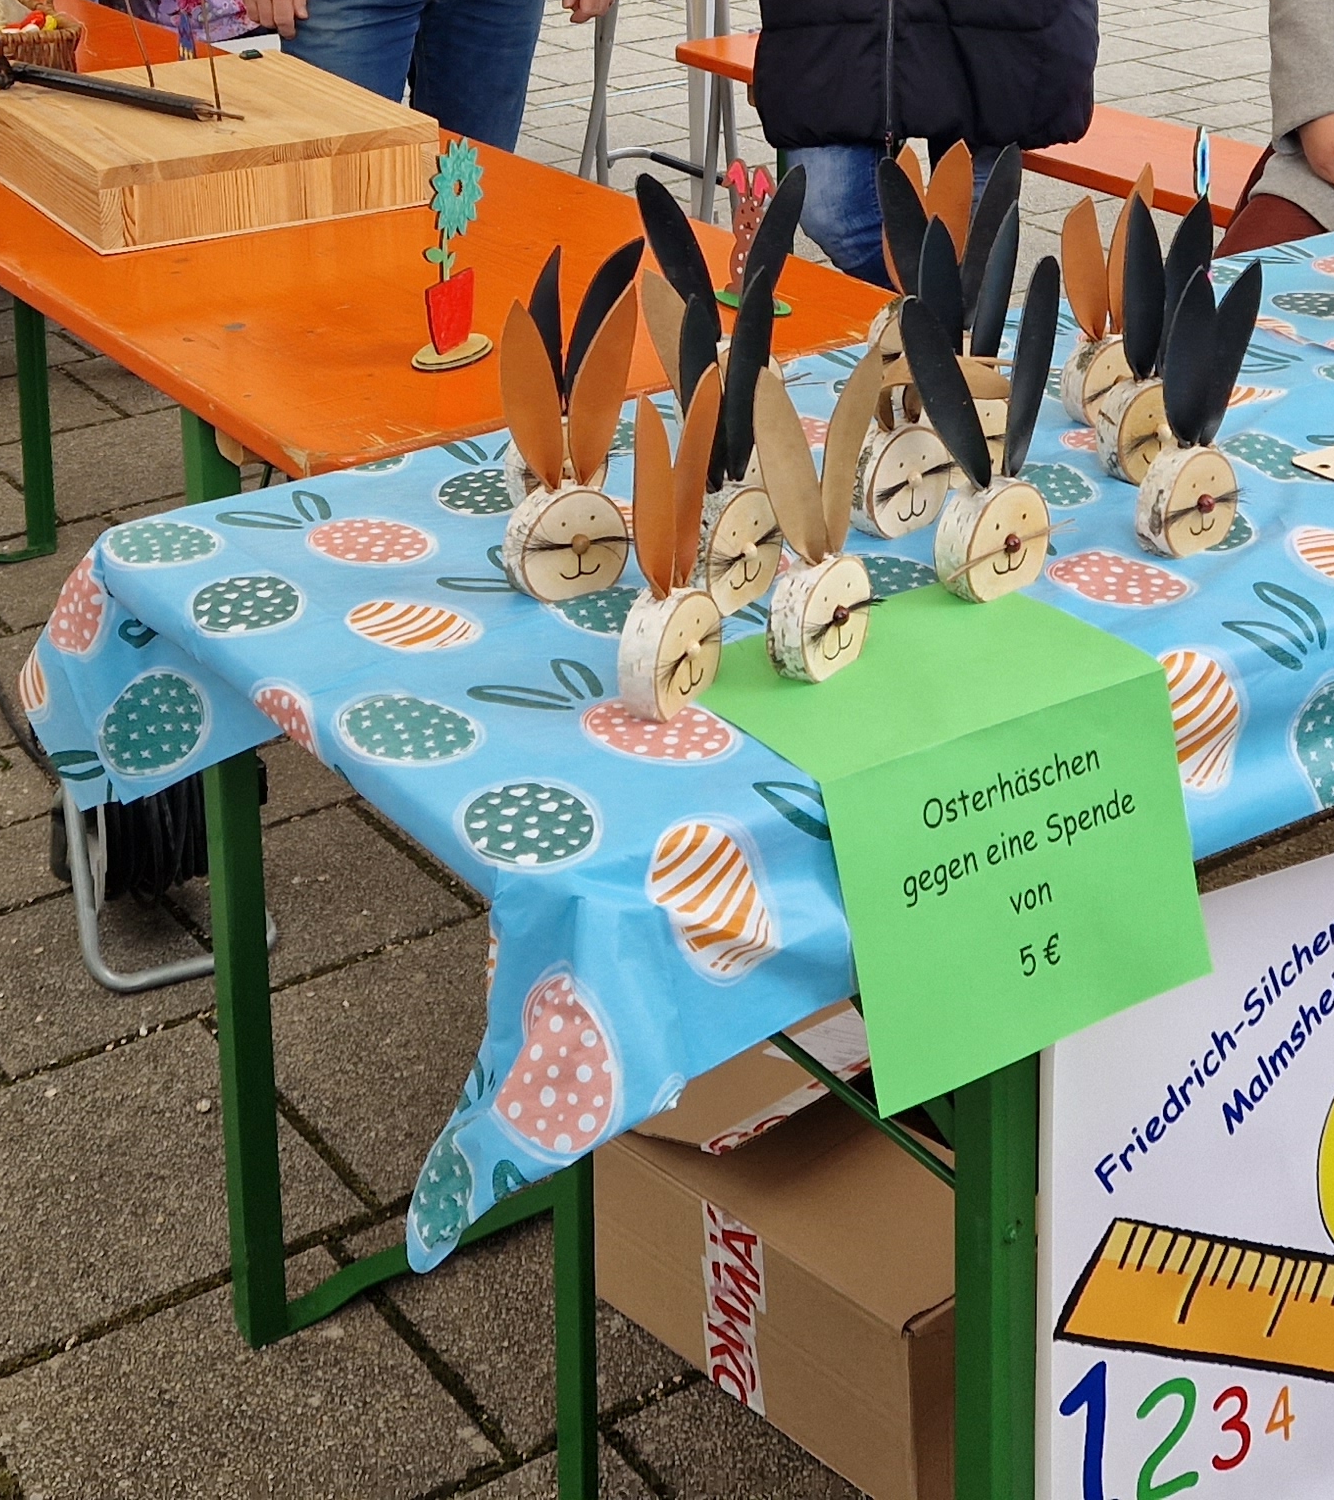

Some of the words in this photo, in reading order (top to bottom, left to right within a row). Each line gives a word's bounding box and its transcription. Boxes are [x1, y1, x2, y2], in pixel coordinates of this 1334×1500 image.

[922, 746, 1101, 829] Osterhäschen
[902, 848, 978, 908] gegen
[986, 827, 1038, 866] eine
[1045, 789, 1136, 846] Spende
[1009, 881, 1053, 915] von
[1019, 943, 1037, 977] 5
[1043, 933, 1061, 965] €
